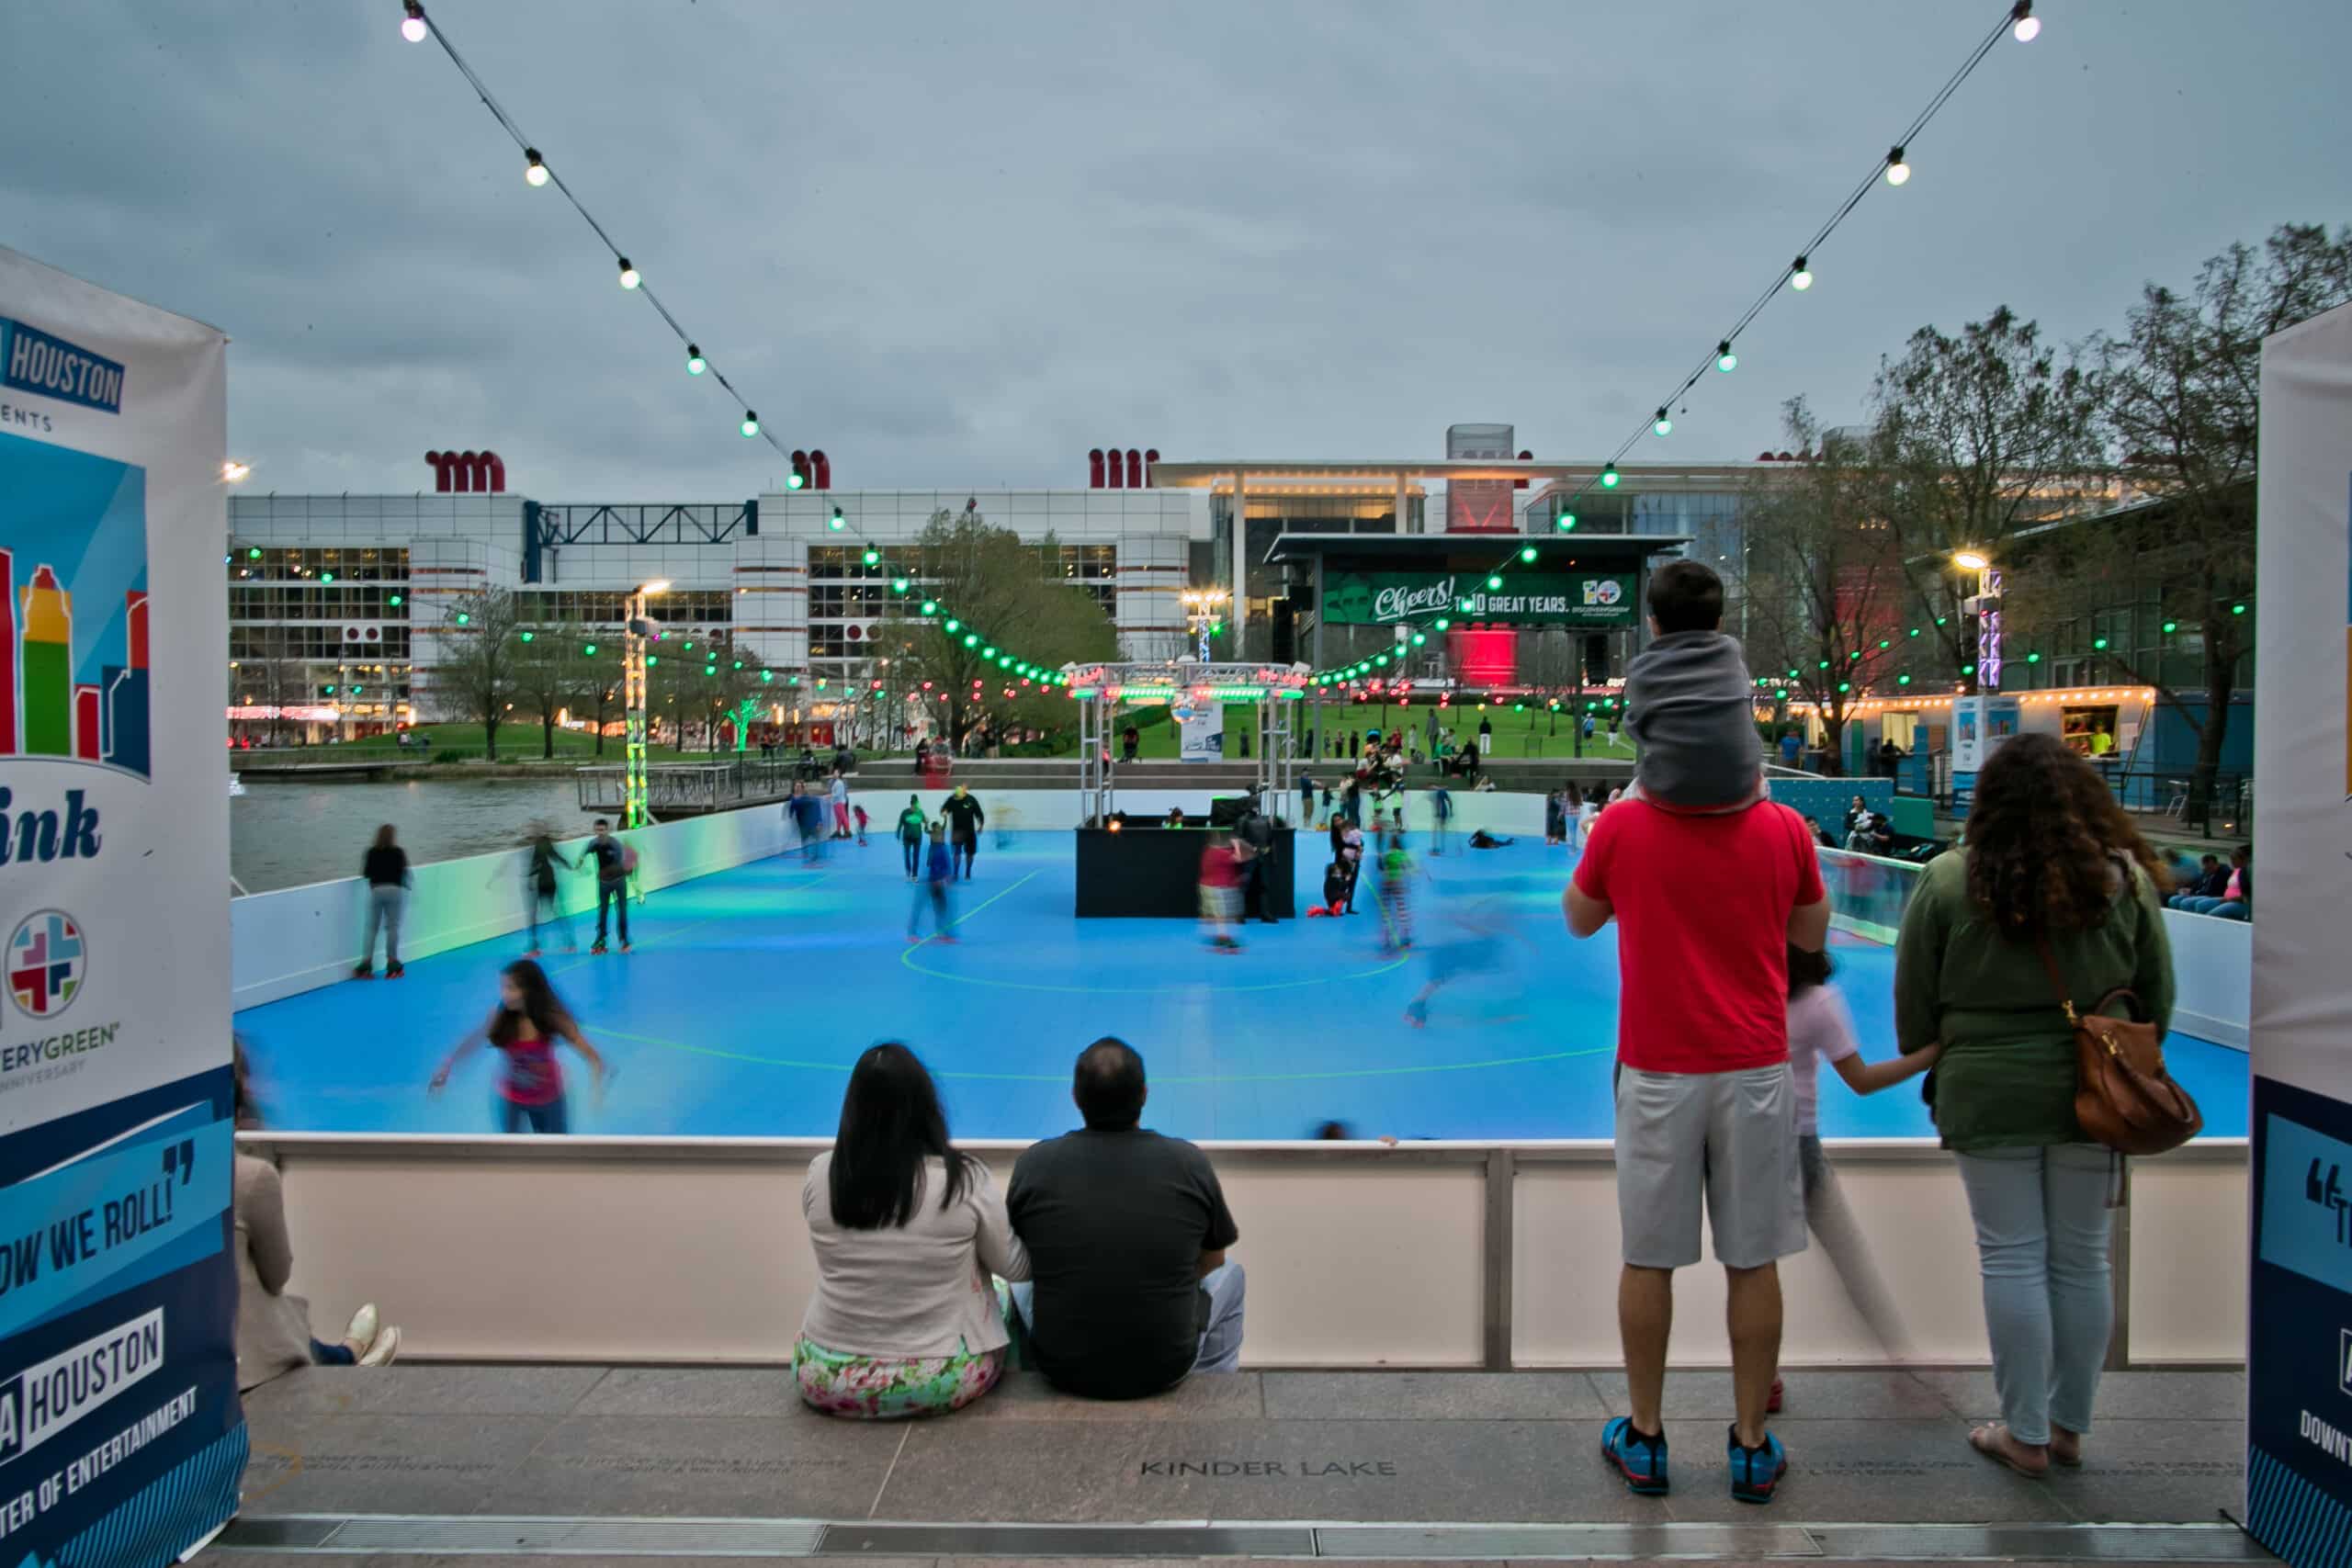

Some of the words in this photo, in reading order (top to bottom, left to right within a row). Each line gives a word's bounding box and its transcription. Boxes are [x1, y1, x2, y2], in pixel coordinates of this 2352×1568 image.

[10, 333, 121, 405] HOUSTON
[1, 404, 52, 433] ENTS
[1375, 576, 1455, 618] Cheers!
[1472, 593, 1486, 613] 10
[1488, 597, 1523, 613] GREAT
[1529, 596, 1569, 613] YEARS.
[0, 786, 102, 866] ink
[50, 1208, 96, 1272] WE
[29, 1320, 159, 1434] HOUSTON
[39, 1472, 63, 1513] OF
[67, 1384, 198, 1495] ENTERTAINMENT
[1141, 1461, 1286, 1477] KINDER
[1299, 1461, 1397, 1477] LAKE
